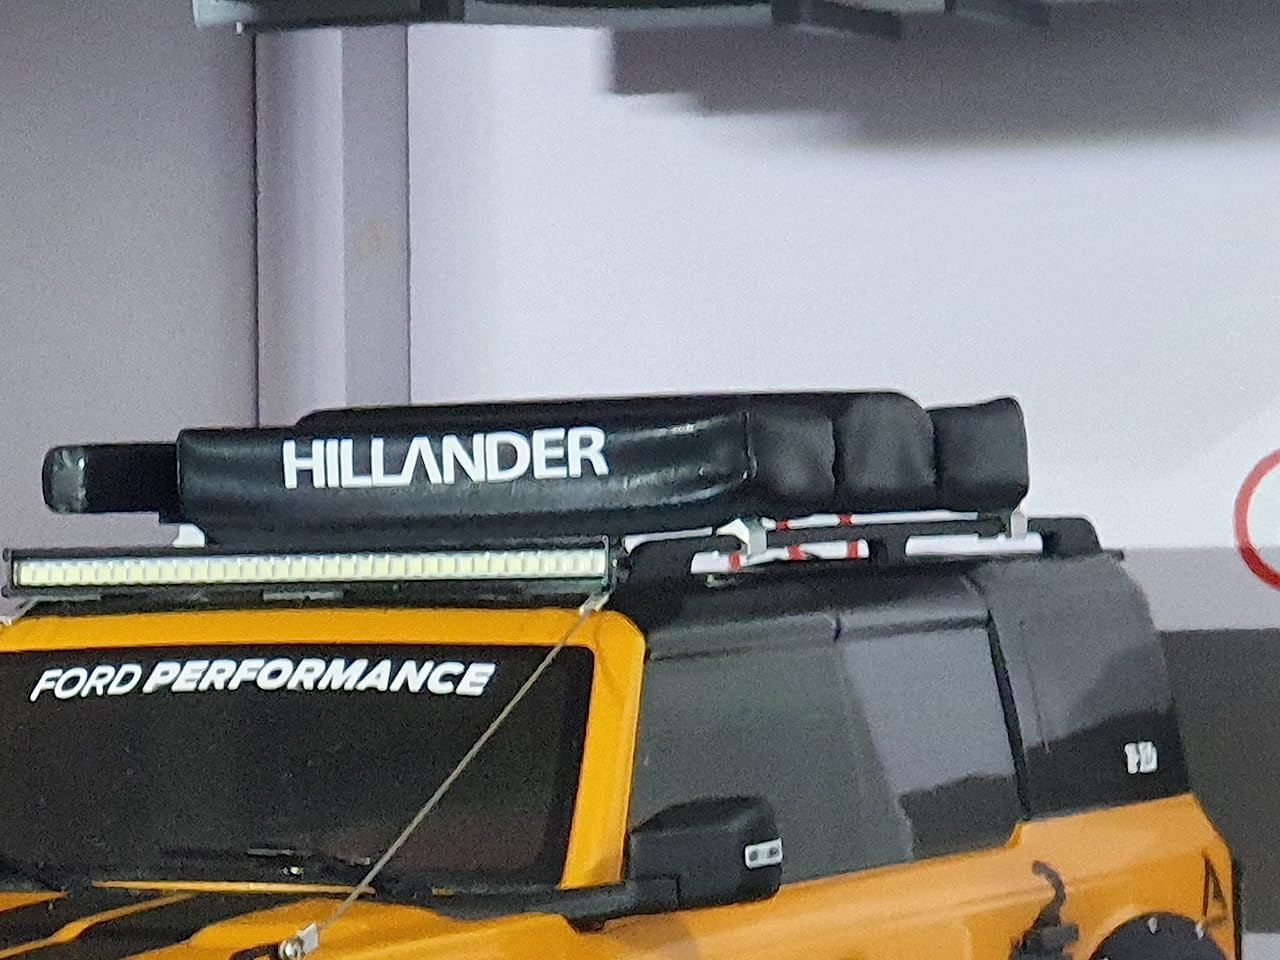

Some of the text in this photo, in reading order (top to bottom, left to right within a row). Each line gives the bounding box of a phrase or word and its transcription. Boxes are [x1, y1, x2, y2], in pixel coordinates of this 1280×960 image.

[282, 425, 609, 489] HILLANDER
[30, 658, 497, 701] FORD PERFORMANCE
